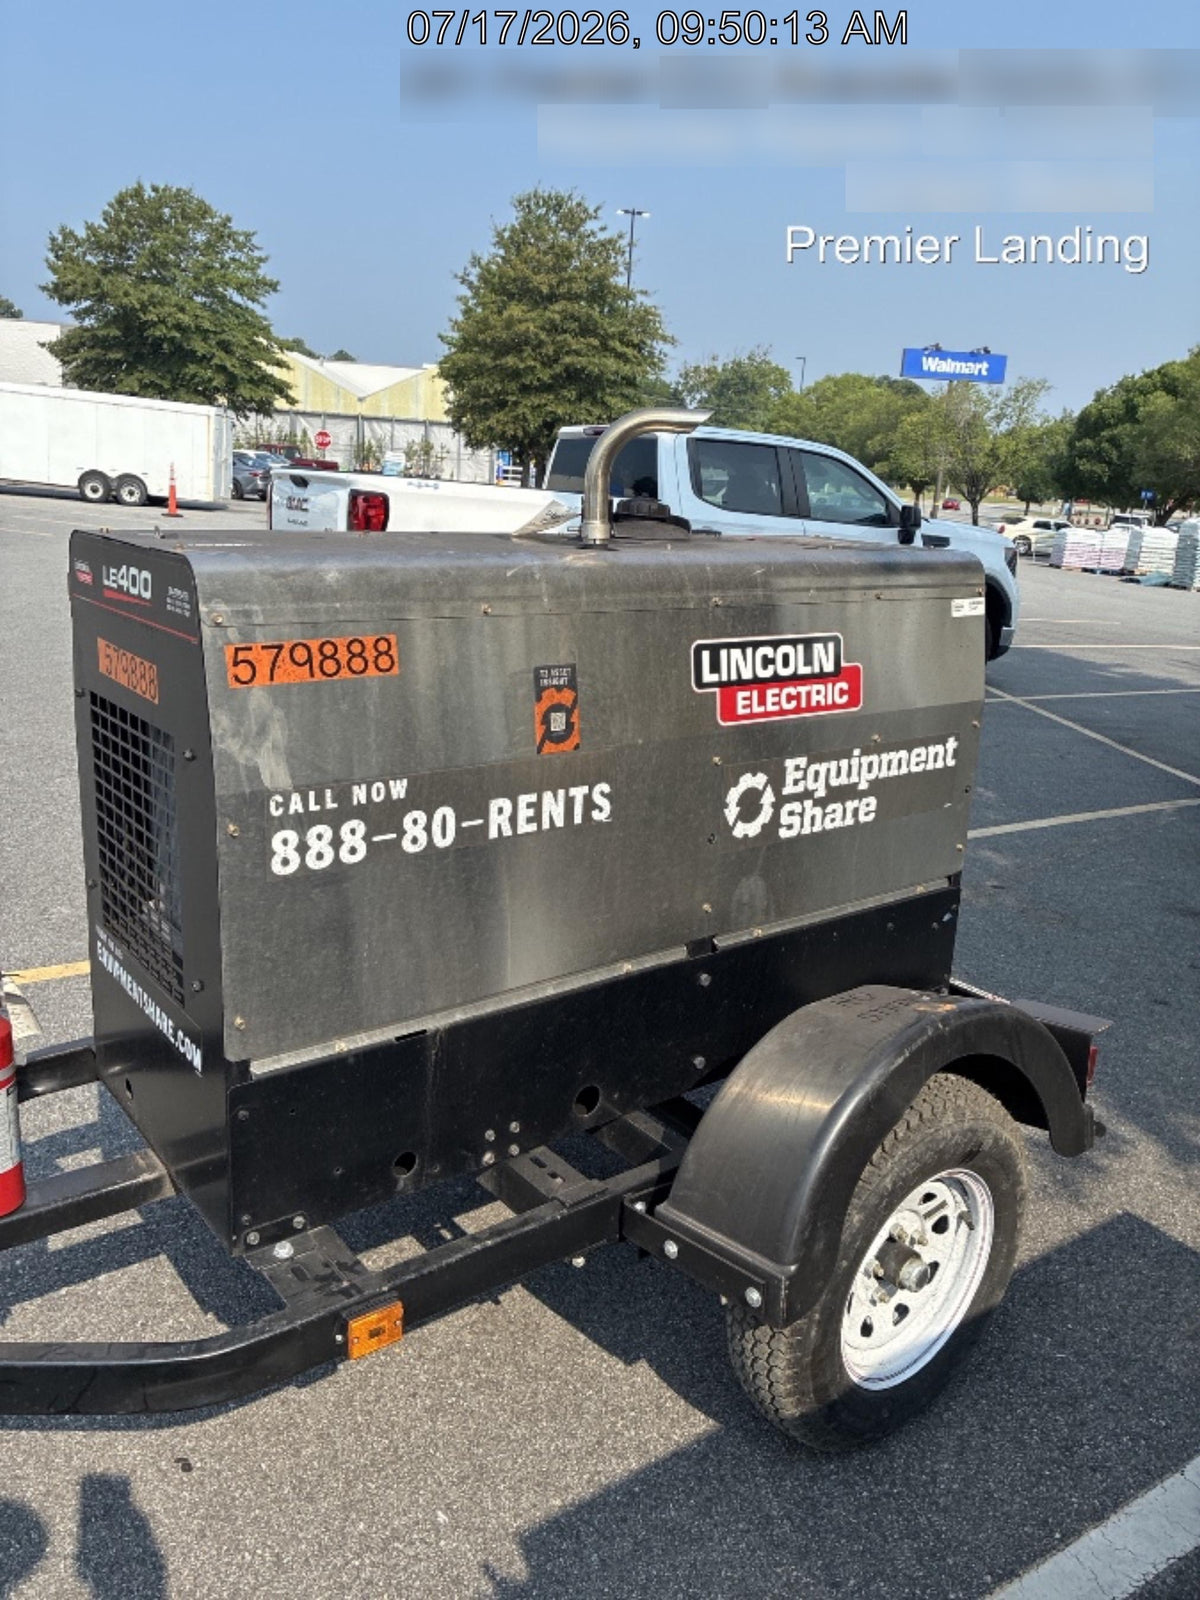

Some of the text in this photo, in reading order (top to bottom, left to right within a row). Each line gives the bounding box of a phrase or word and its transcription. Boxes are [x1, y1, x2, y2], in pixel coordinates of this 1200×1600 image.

[922, 356, 989, 376] Walmart
[102, 565, 152, 599] LE400
[104, 644, 157, 702] 579888
[232, 636, 396, 685] 579888
[701, 641, 835, 683] LINCOLN
[736, 682, 849, 715] ELECTRIC
[781, 736, 959, 798] Equipment
[269, 778, 409, 817] CALL NOW
[778, 796, 878, 839] Share
[270, 782, 613, 876] 888-80-RENTS
